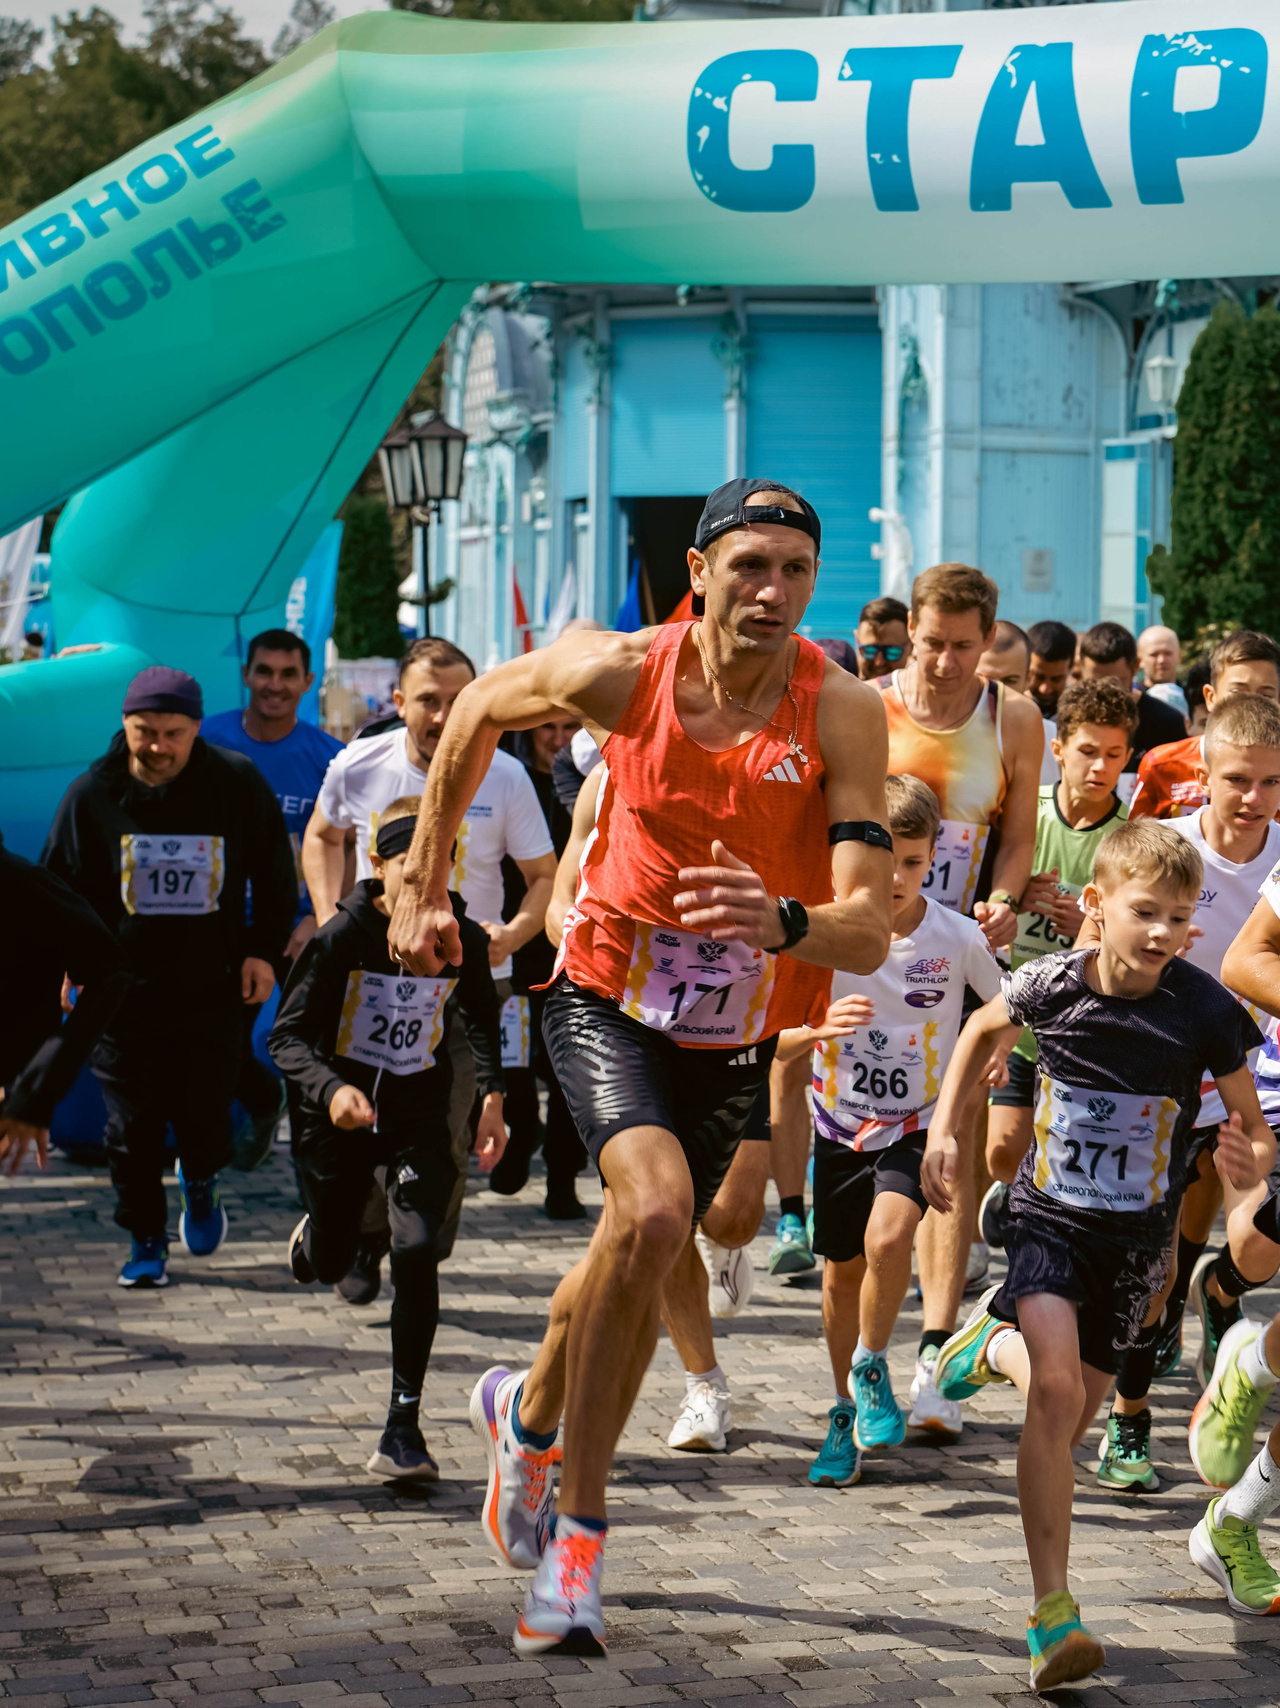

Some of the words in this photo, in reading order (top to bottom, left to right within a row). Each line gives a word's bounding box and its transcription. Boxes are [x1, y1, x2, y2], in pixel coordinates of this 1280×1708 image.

[710, 514, 734, 529] DRI-FIT
[148, 869, 196, 895] 197
[905, 976, 949, 984] TRIATHLON
[668, 981, 735, 1021] 171
[368, 1014, 423, 1050] 268
[671, 1023, 714, 1035] ОЛЬСКИЙ
[714, 1025, 736, 1036] КРАЙ
[852, 1062, 908, 1099] 266
[1063, 1139, 1129, 1181] 271
